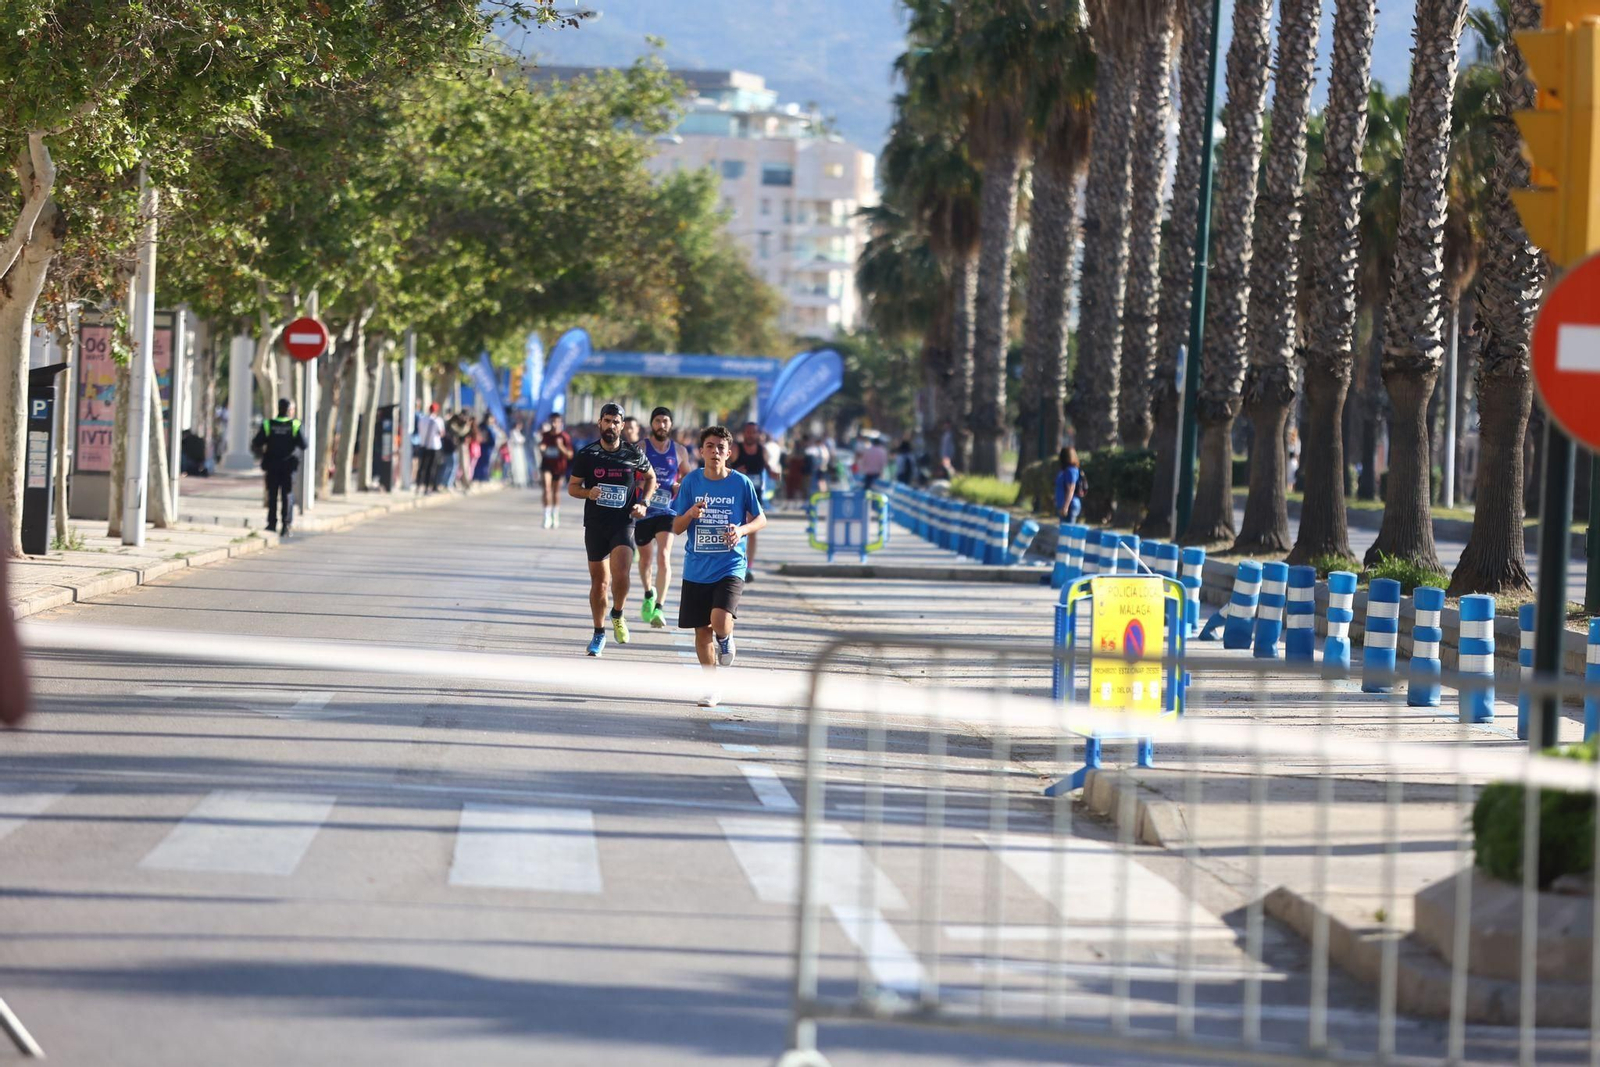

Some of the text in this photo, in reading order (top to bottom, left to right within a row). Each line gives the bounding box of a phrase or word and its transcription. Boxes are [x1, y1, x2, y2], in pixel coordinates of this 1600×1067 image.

[86, 337, 106, 353] 06
[32, 400, 46, 416] P
[600, 491, 623, 501] 2060
[695, 495, 735, 505] mayoral
